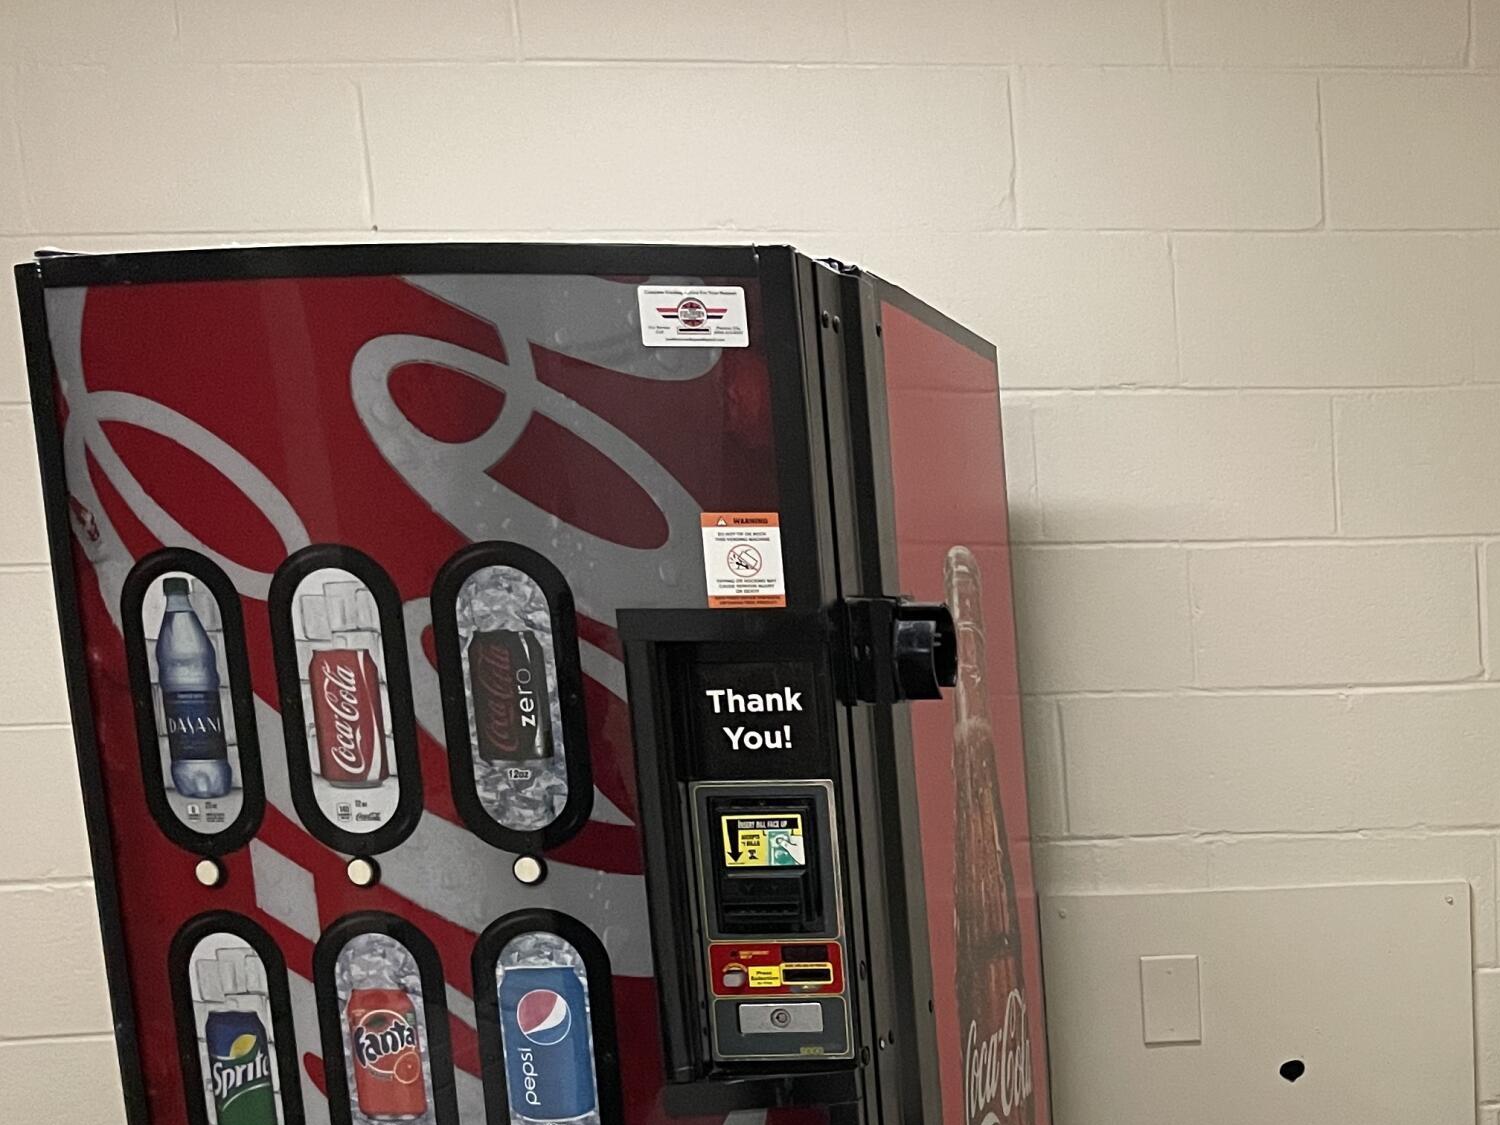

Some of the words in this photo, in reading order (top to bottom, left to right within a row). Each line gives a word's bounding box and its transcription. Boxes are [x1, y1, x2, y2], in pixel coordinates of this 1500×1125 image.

[321, 659, 366, 774] Coca-Cola
[516, 667, 536, 728] zero
[705, 686, 803, 714] Thank
[169, 716, 221, 735] DASANI
[722, 725, 793, 750] You!
[508, 769, 530, 779] 12oz
[212, 1051, 269, 1100] Sprite
[517, 1047, 541, 1106] pepsi
